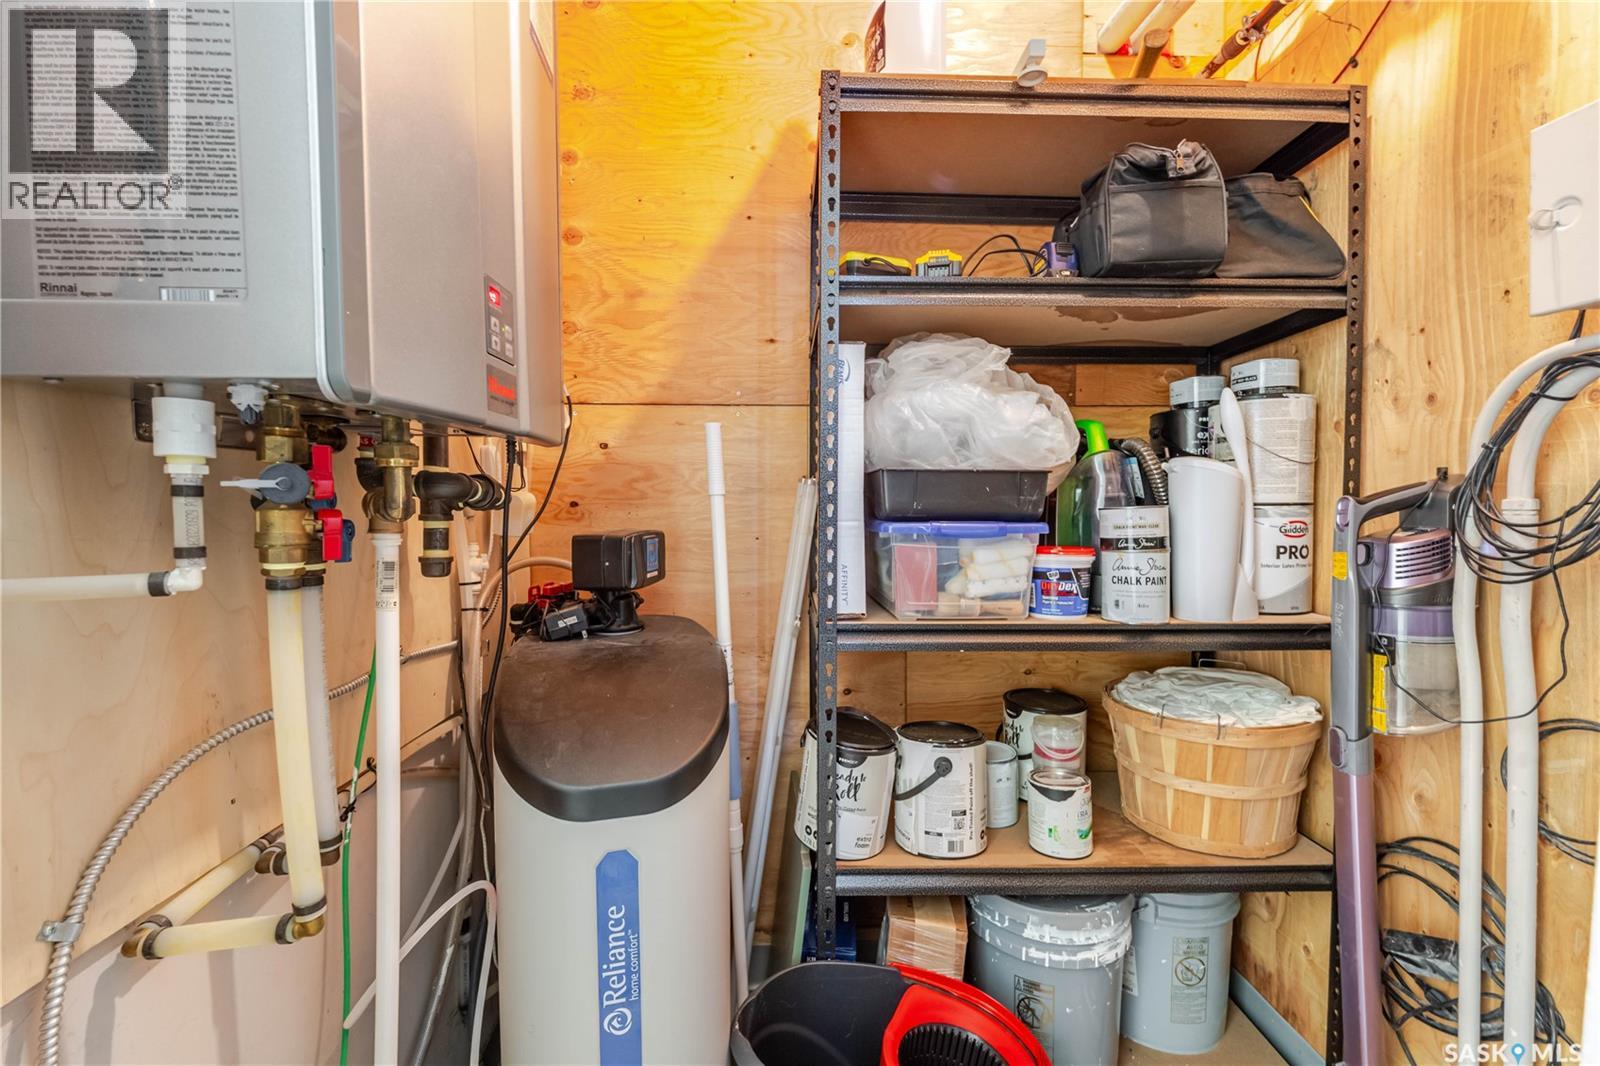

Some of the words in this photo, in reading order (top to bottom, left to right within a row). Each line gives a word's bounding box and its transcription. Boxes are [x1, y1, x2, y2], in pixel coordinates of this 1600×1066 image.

[40, 282, 77, 292] Rinnai
[1275, 545, 1310, 560] PRO
[1112, 575, 1143, 586] CHALK
[602, 904, 626, 1008] Reliance
[629, 972, 639, 1001] home
